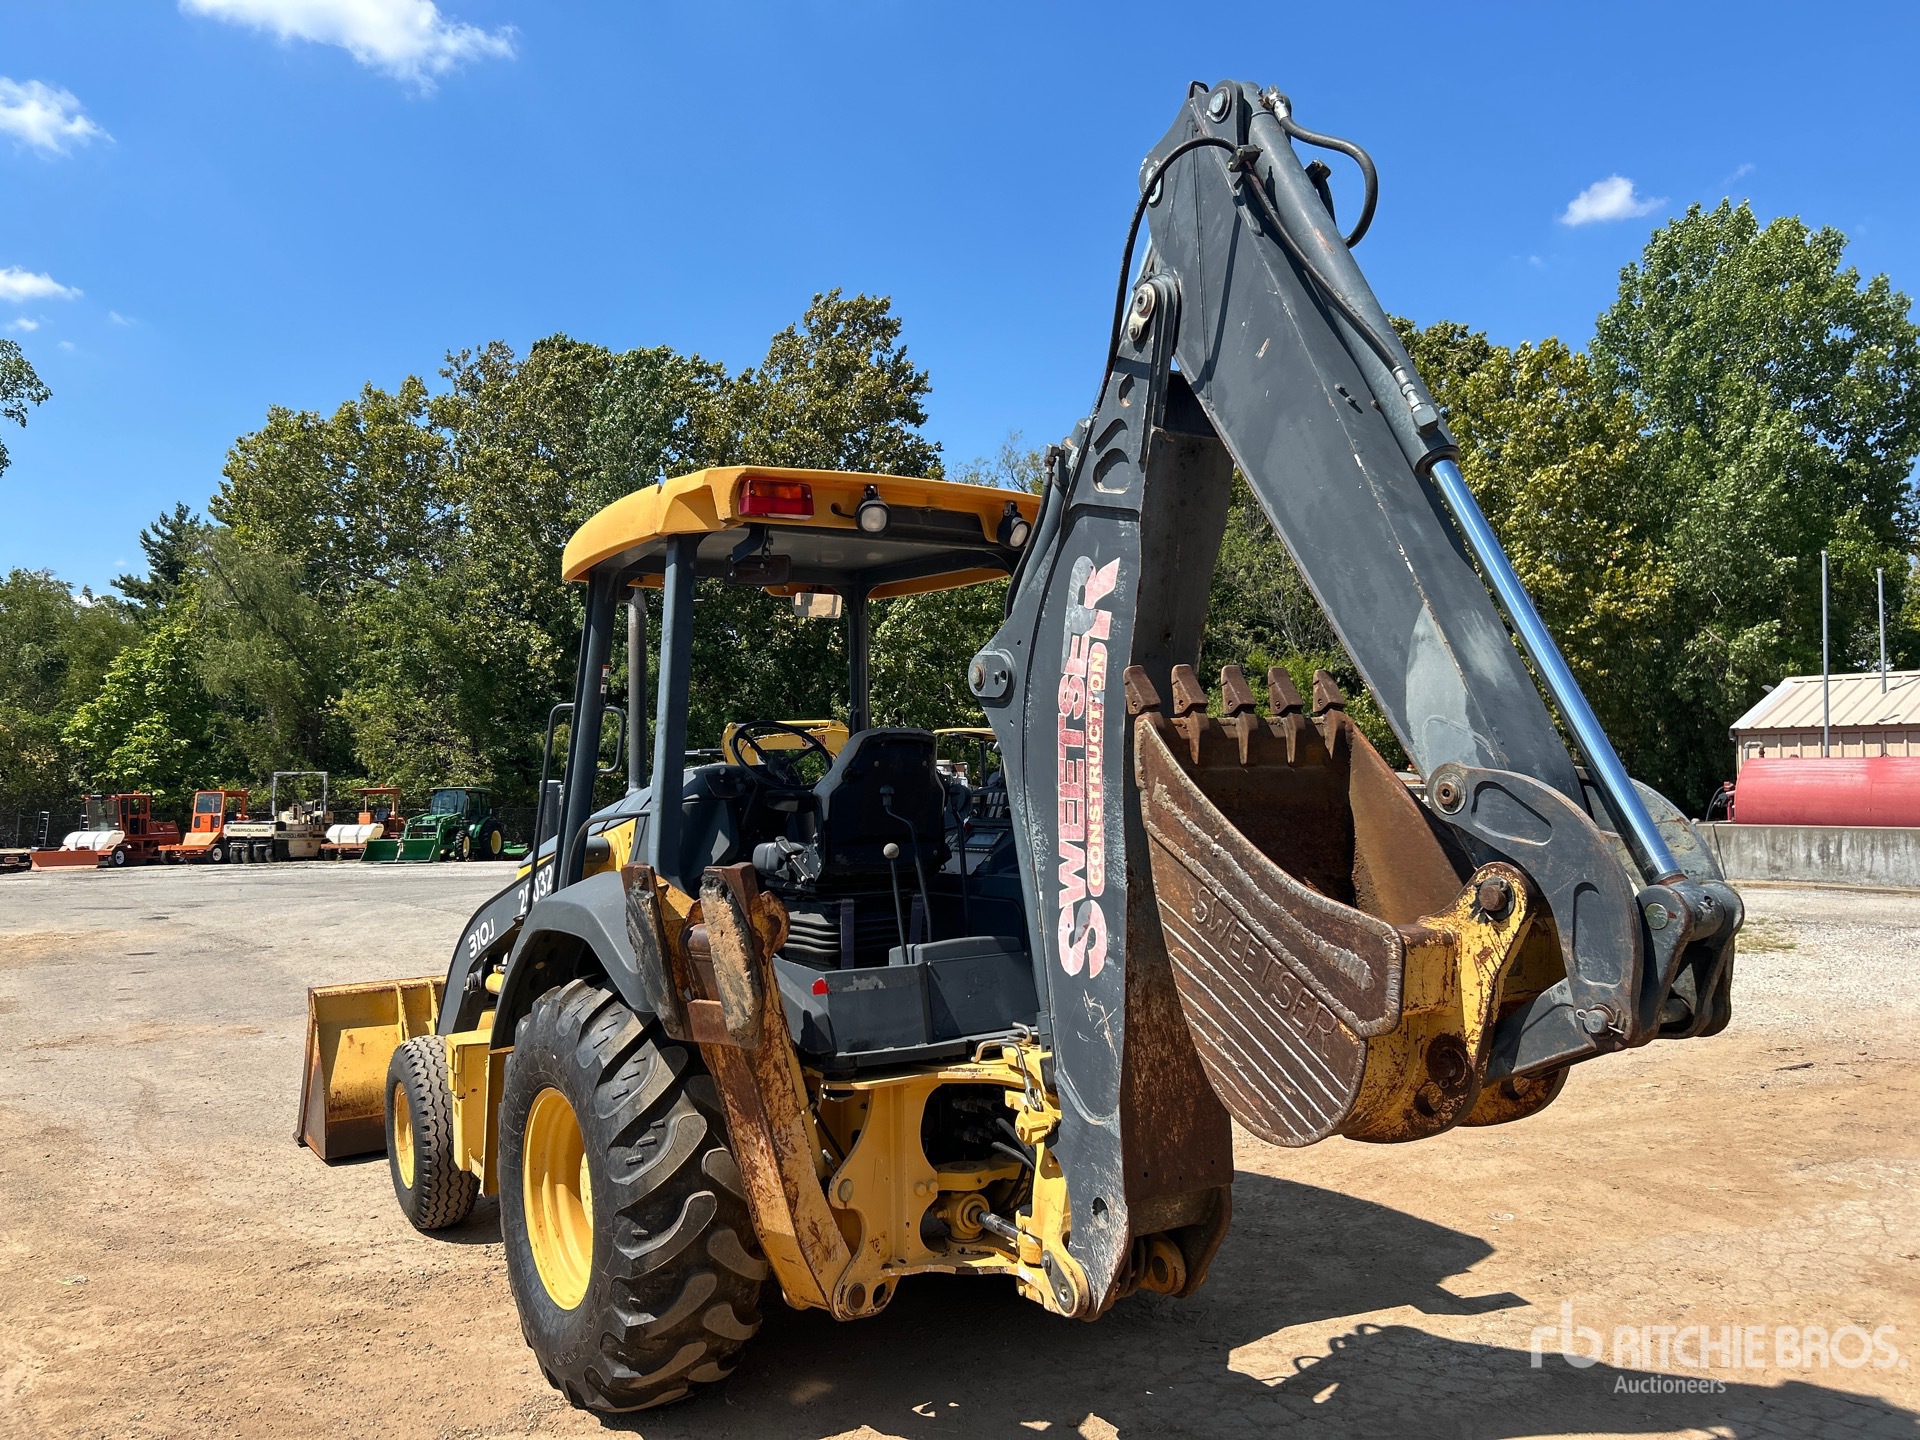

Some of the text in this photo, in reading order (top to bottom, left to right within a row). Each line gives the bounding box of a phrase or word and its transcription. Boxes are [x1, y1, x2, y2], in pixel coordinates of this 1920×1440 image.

[1059, 555, 1121, 979] SWEETSER
[468, 918, 495, 958] 310J
[1191, 887, 1339, 1059] SWEETSER
